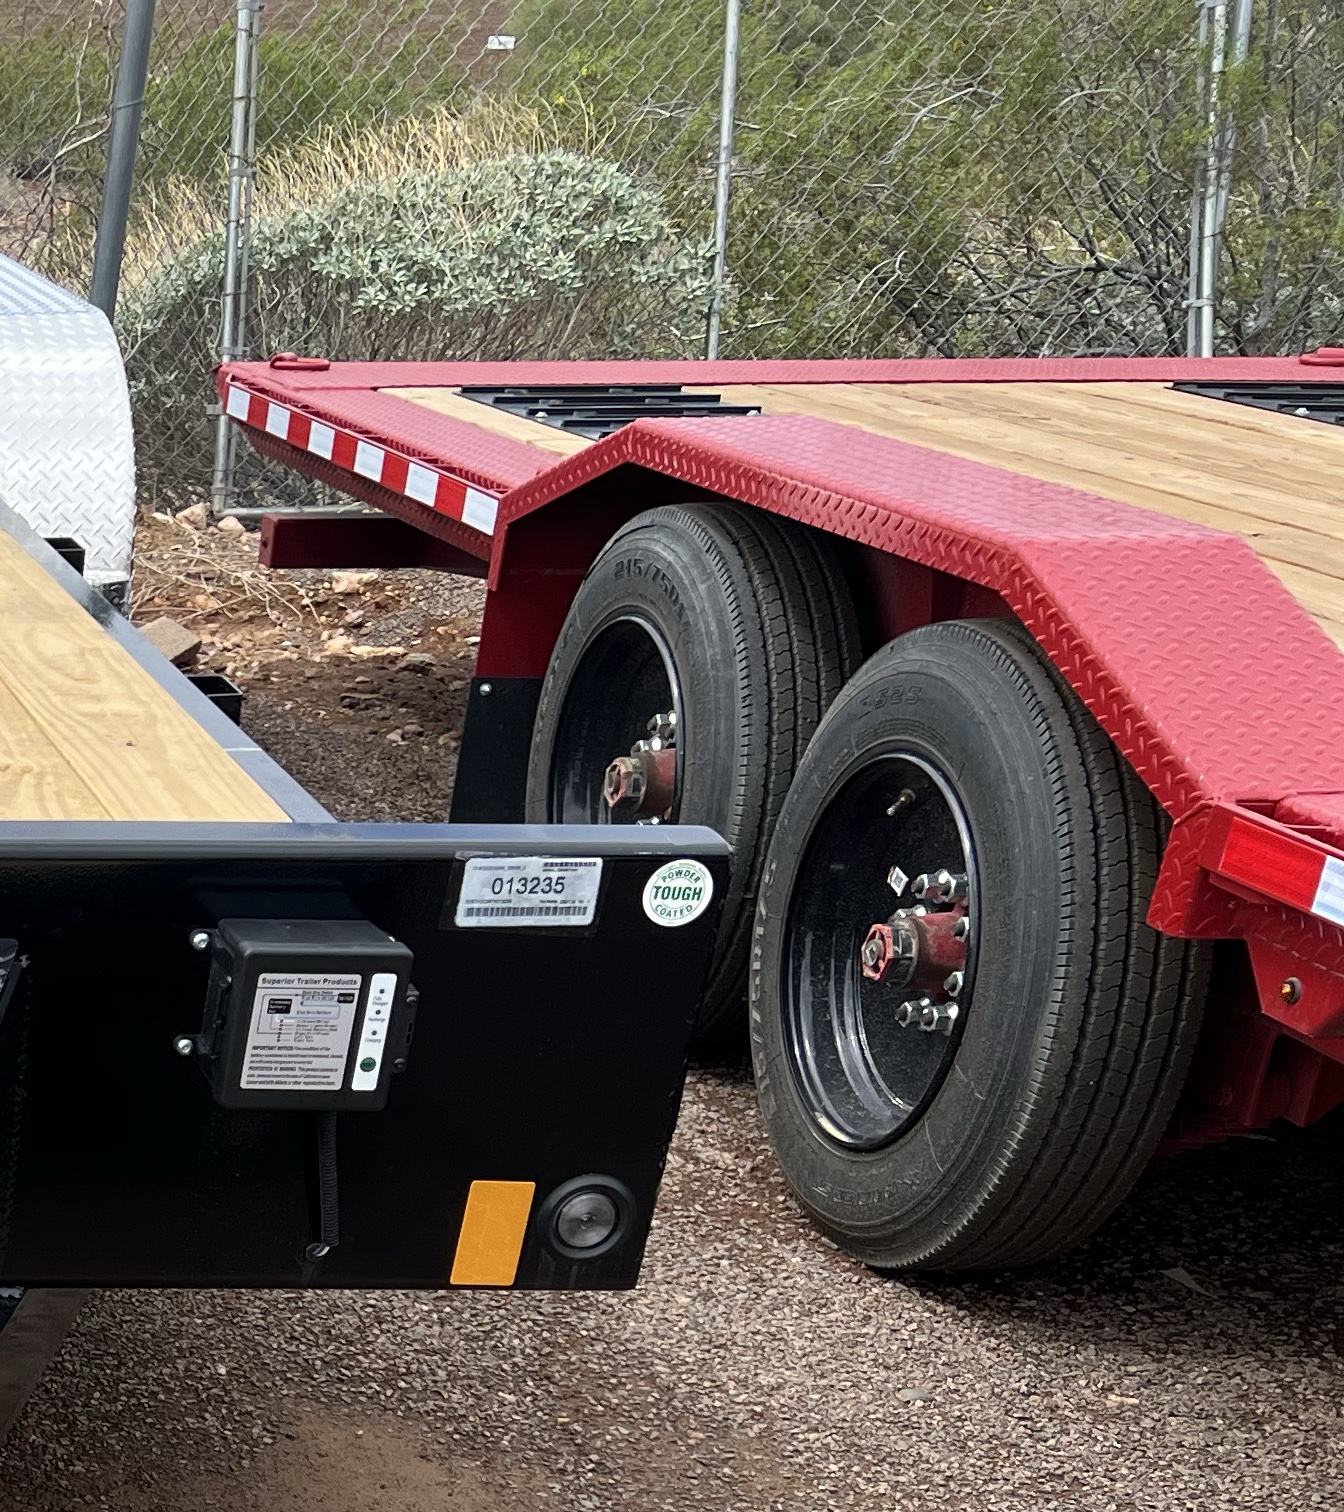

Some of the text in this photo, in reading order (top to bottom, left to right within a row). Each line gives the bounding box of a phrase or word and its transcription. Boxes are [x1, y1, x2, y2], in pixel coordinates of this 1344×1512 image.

[661, 869, 701, 884] POWDER
[492, 876, 566, 895] 013235
[653, 885, 703, 902] TOUGH
[655, 904, 693, 918] COATED
[262, 977, 358, 986] Superior Trailer Products
